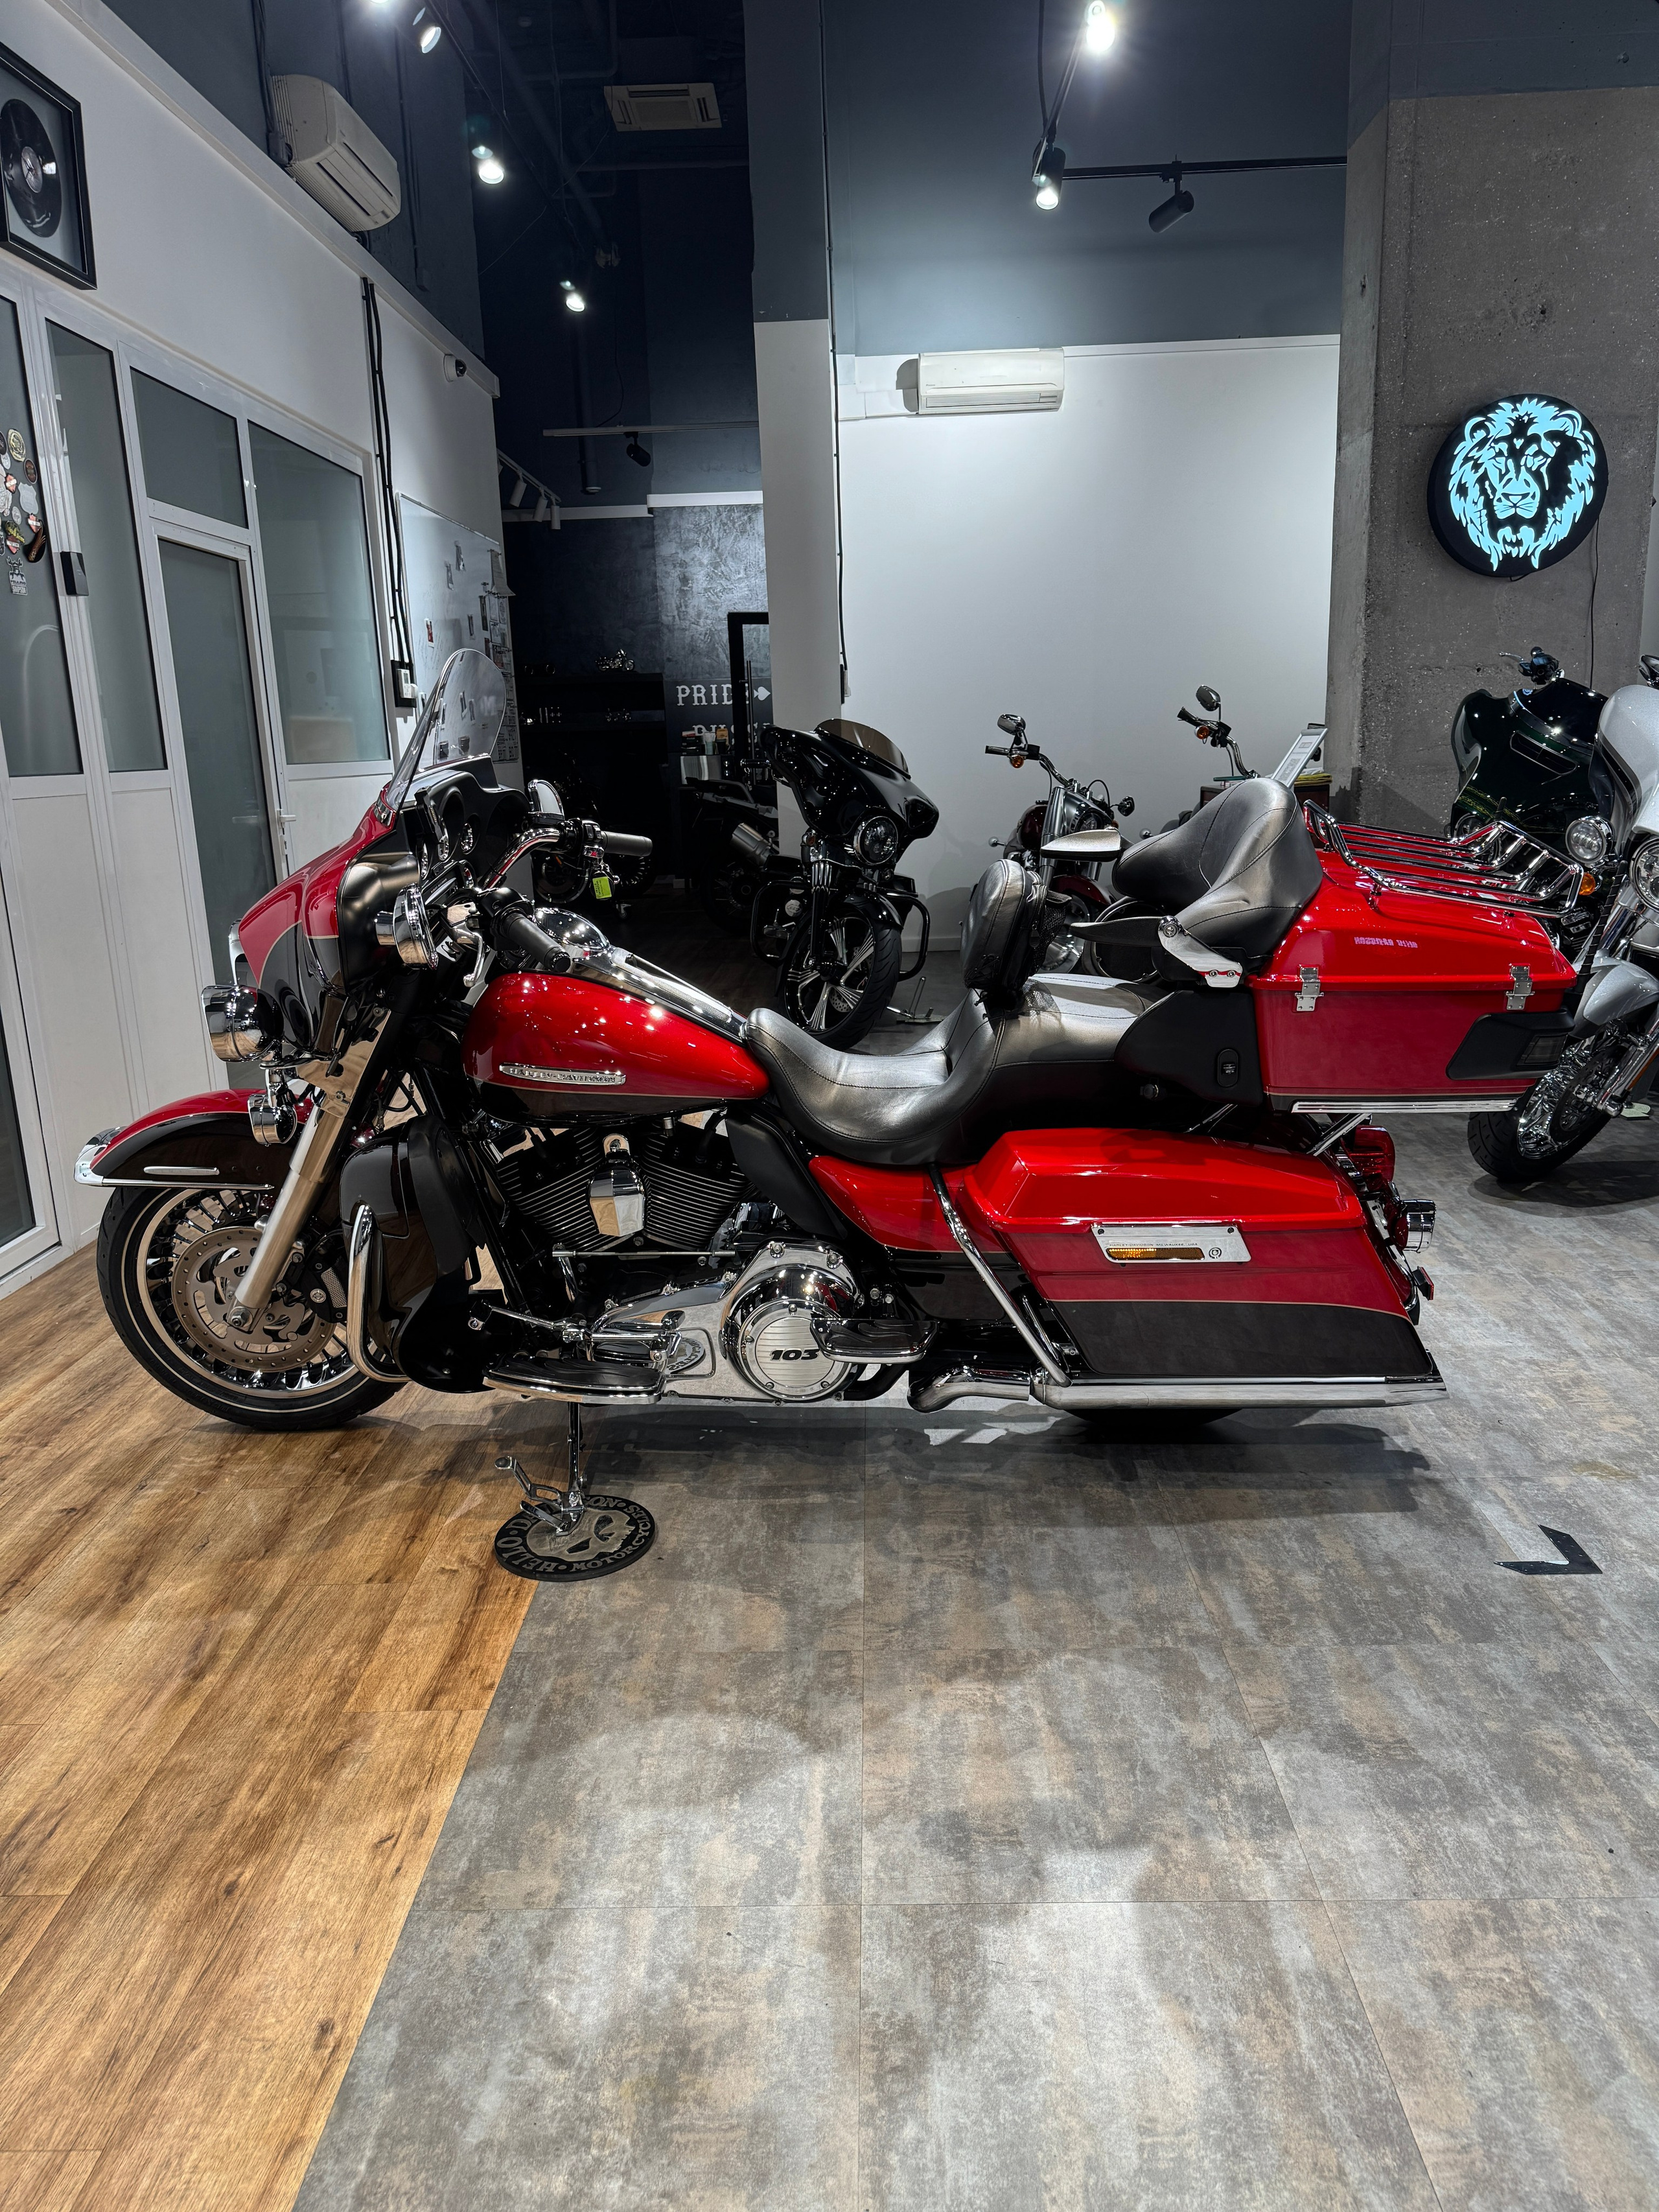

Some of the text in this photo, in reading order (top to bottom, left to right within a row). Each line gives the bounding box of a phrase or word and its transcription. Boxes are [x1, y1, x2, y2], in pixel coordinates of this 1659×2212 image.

[509, 1067, 616, 1083] HARLEY-DAVIDSON
[771, 1349, 820, 1362] 103
[496, 1536, 560, 1573] HELLO
[570, 1505, 651, 1572] MOTORCYCLES
